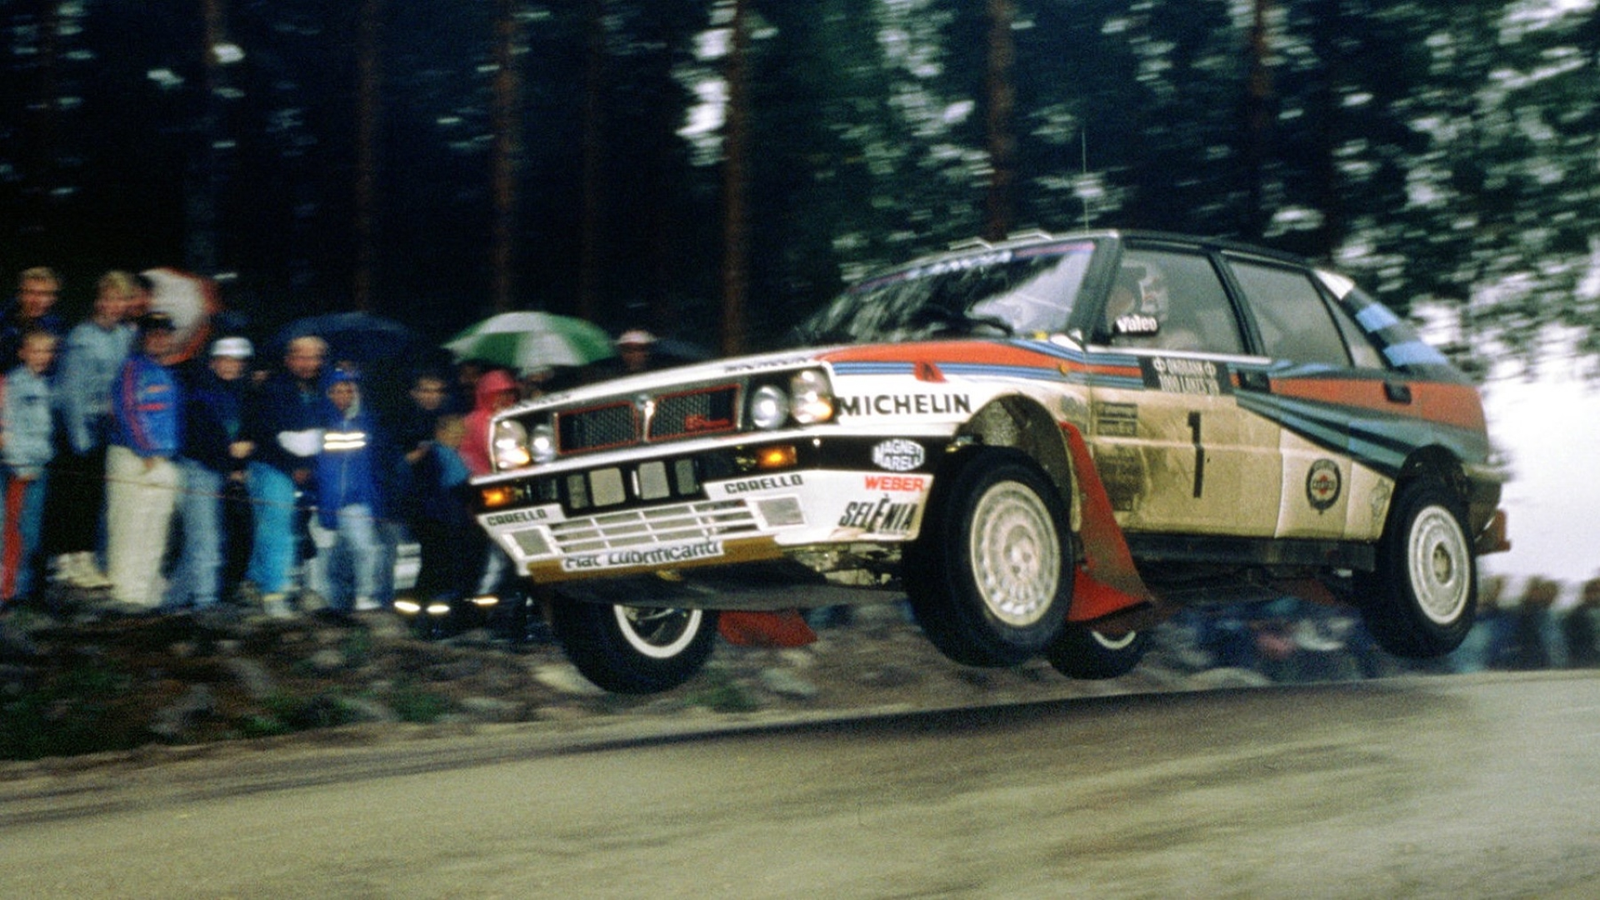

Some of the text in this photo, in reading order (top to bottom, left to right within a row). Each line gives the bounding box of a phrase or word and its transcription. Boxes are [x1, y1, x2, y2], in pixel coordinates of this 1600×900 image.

[837, 393, 972, 416] MICHELIN
[1187, 410, 1205, 498] 1
[724, 473, 804, 494] CARELLO
[864, 475, 925, 493] WEBER
[486, 508, 548, 527] CARELLO
